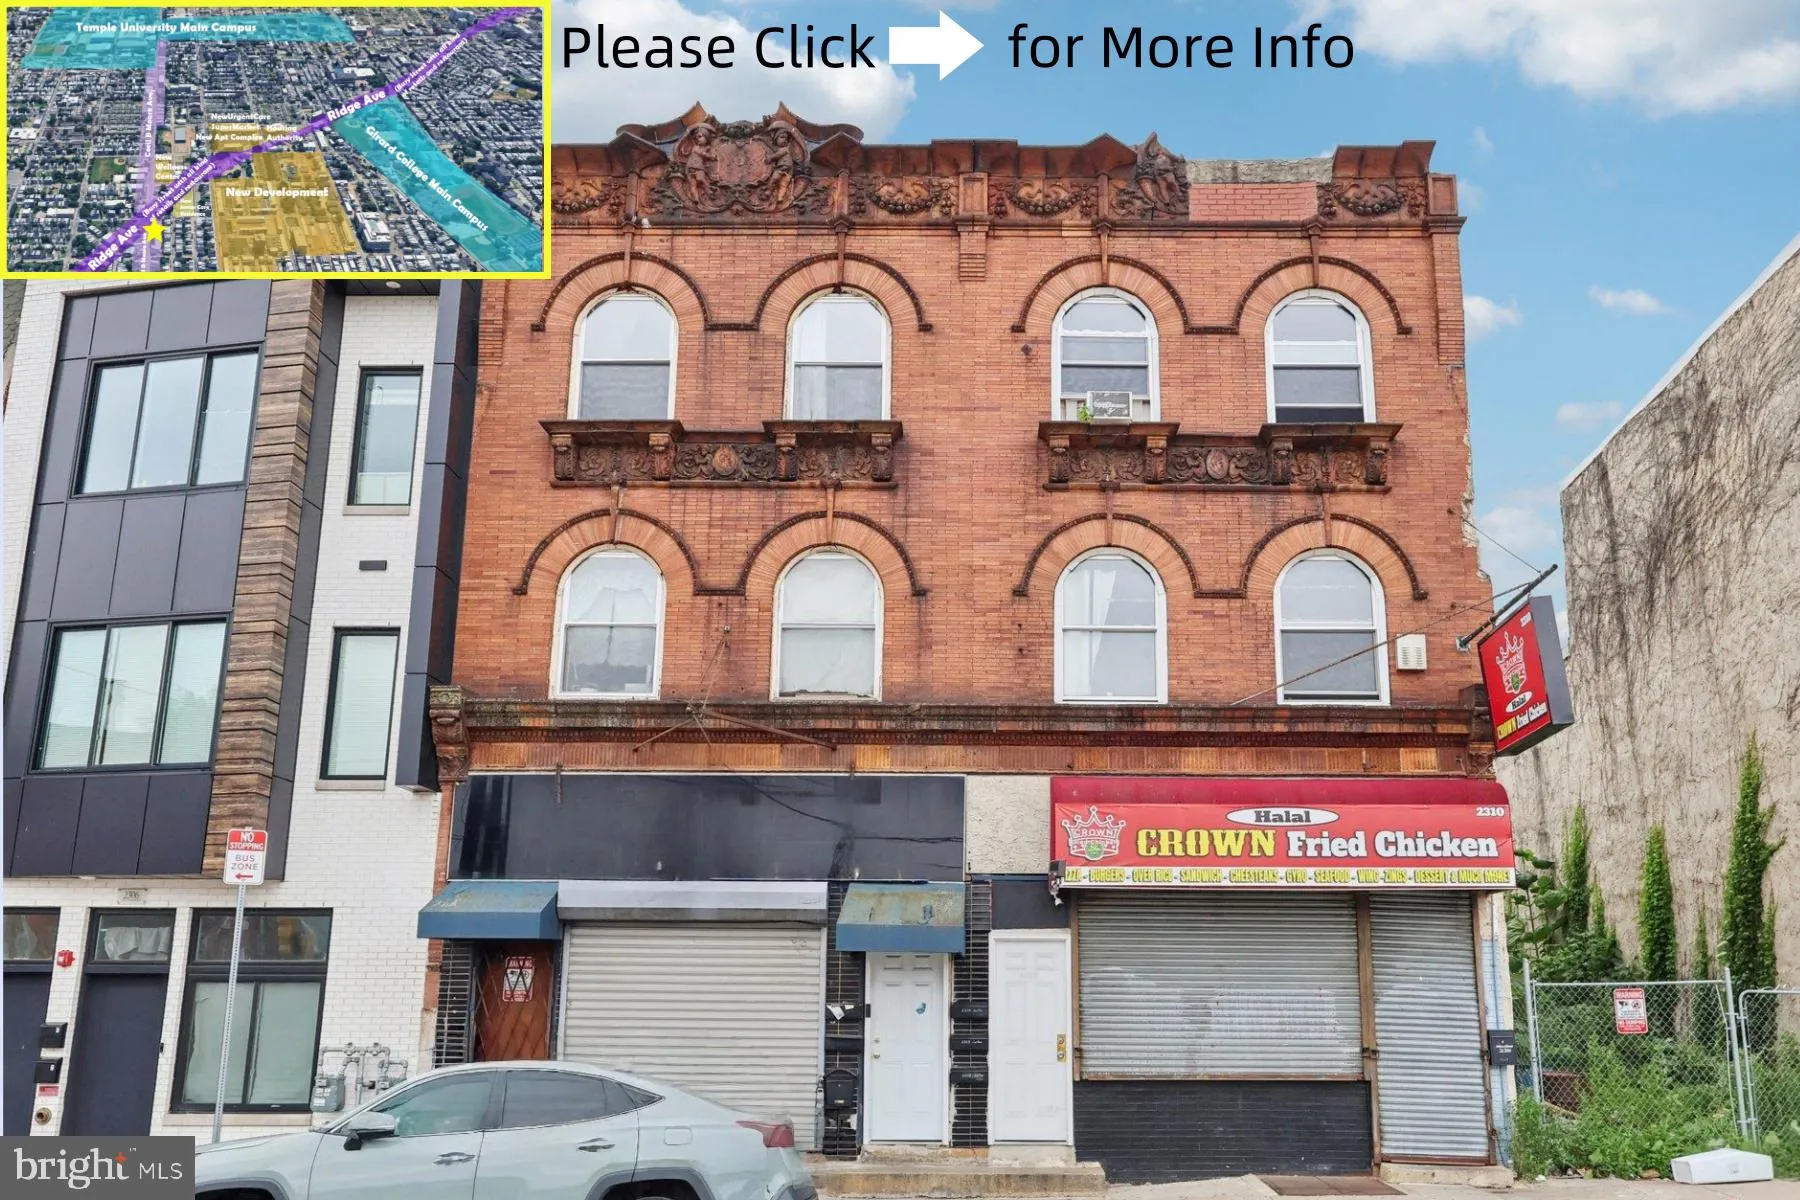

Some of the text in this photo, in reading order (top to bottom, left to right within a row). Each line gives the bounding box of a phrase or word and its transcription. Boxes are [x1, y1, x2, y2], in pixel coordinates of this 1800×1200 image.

[1254, 810, 1311, 823] Halal
[1476, 807, 1505, 817] 2310
[240, 831, 255, 843] NO
[1074, 829, 1113, 837] CROWN
[229, 842, 264, 850] STOPPING
[1137, 828, 1277, 857] CROWN
[1286, 830, 1367, 858] Fried
[1374, 830, 1499, 858] Chicken
[235, 854, 255, 862] BUS
[231, 862, 258, 870] ZONE
[1088, 868, 1125, 882] BURGERS
[1179, 868, 1222, 882] SANDWICH
[1285, 869, 1308, 883] GYRO
[1314, 869, 1350, 883] SEAFOOD
[1414, 869, 1448, 883] DESSERT
[1457, 869, 1482, 883] MUCH
